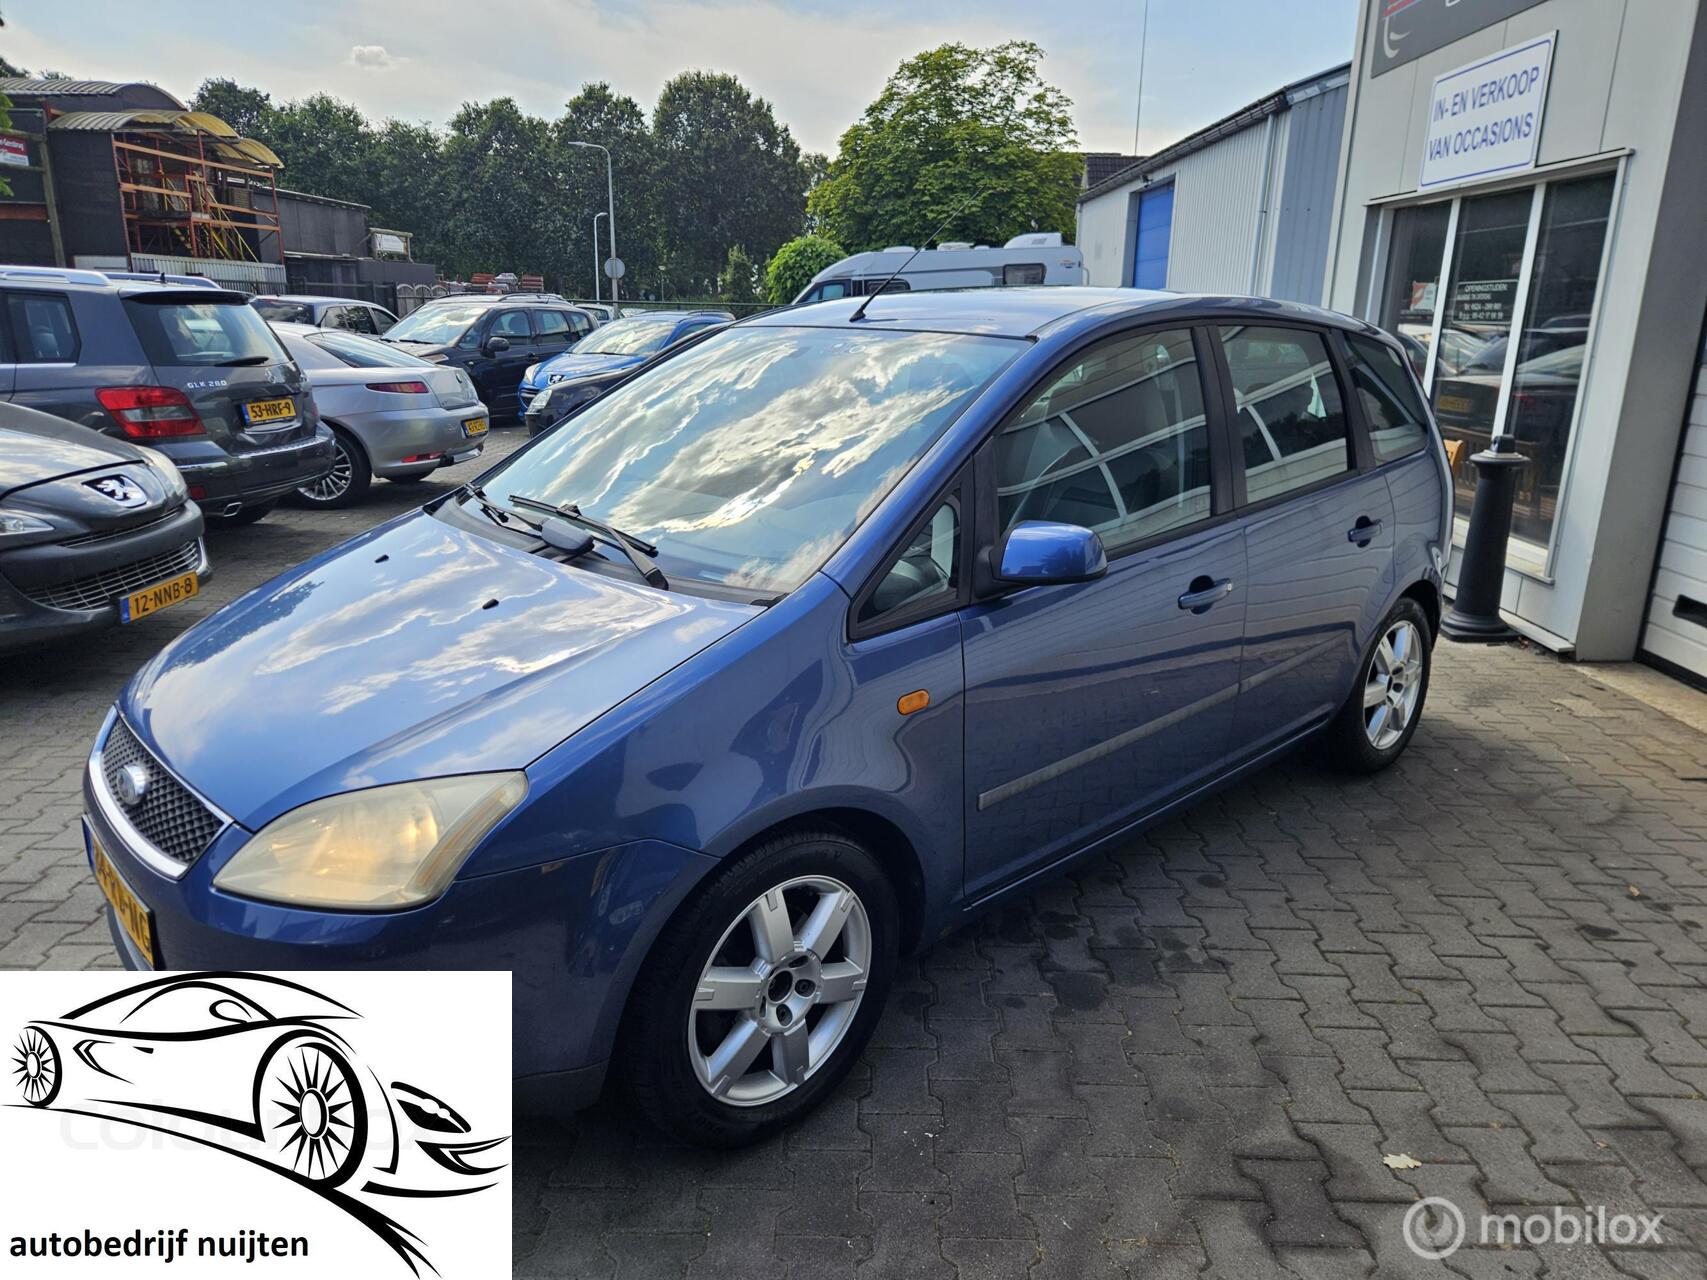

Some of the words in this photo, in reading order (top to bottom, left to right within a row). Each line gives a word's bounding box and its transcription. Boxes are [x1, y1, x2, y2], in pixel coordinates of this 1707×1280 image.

[1433, 98, 1449, 122] IN-
[1451, 89, 1469, 117] EN
[1471, 66, 1540, 110] VERKOOP
[1428, 134, 1450, 161] VAN
[1453, 112, 1533, 156] OCCASIONS
[250, 402, 292, 418] 53-HRF-9
[134, 577, 192, 615] 12-NNB-8
